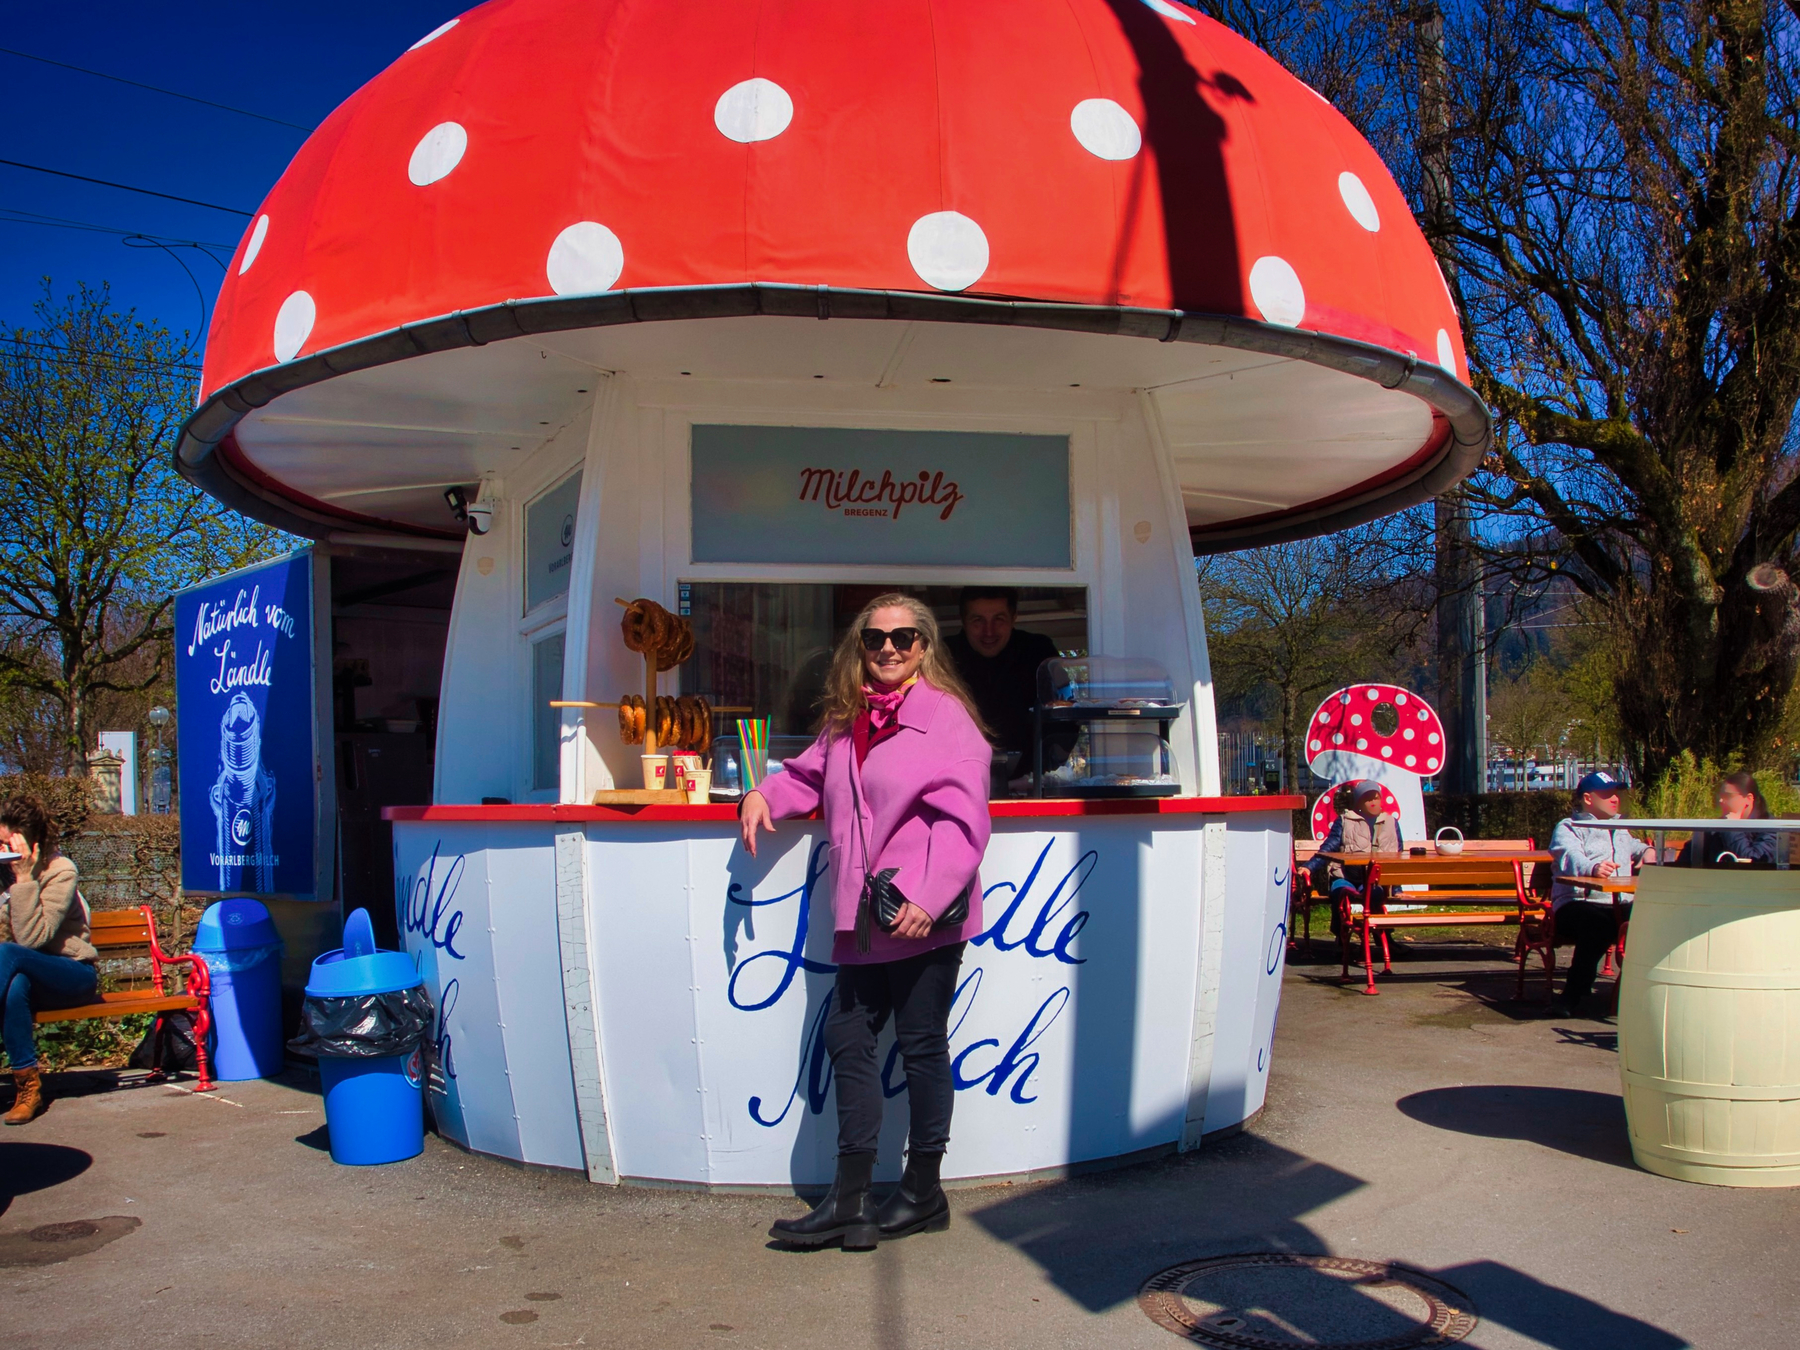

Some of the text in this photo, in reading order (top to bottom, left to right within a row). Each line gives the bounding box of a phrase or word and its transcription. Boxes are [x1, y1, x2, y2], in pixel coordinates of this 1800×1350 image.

[799, 467, 963, 520] Milchpilz
[844, 508, 888, 517] BREGENZ
[188, 584, 295, 657] Natürlich vom
[210, 639, 272, 694] Ländle
[394, 839, 466, 960] ndle
[728, 836, 1093, 1012] Ldle
